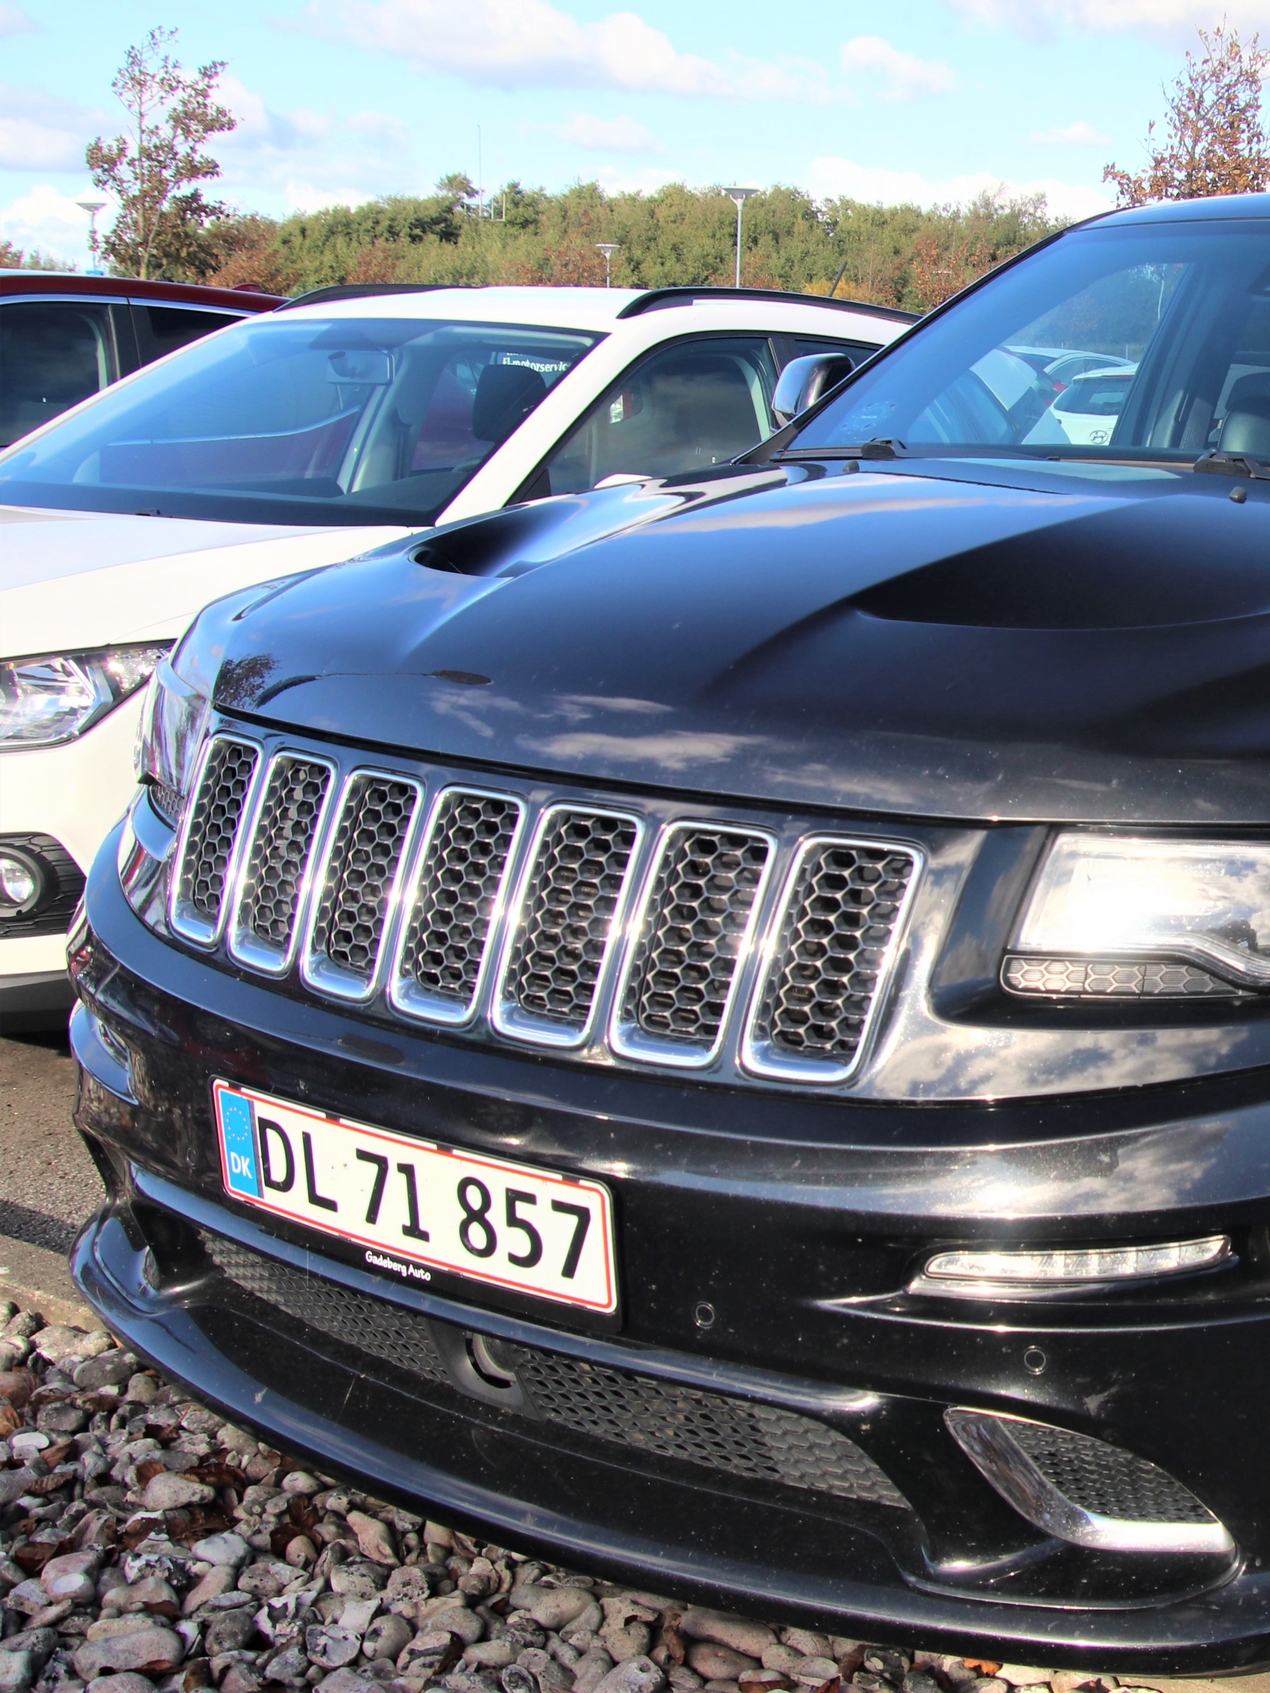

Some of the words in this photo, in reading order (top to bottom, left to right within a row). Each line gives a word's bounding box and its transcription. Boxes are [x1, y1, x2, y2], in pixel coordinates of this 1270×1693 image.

[230, 1151, 253, 1179] DK
[257, 1116, 338, 1213] DL
[355, 1147, 430, 1242] 71
[457, 1176, 591, 1280] 857
[365, 1250, 407, 1277] Gadeberg
[407, 1264, 431, 1281] Auto
